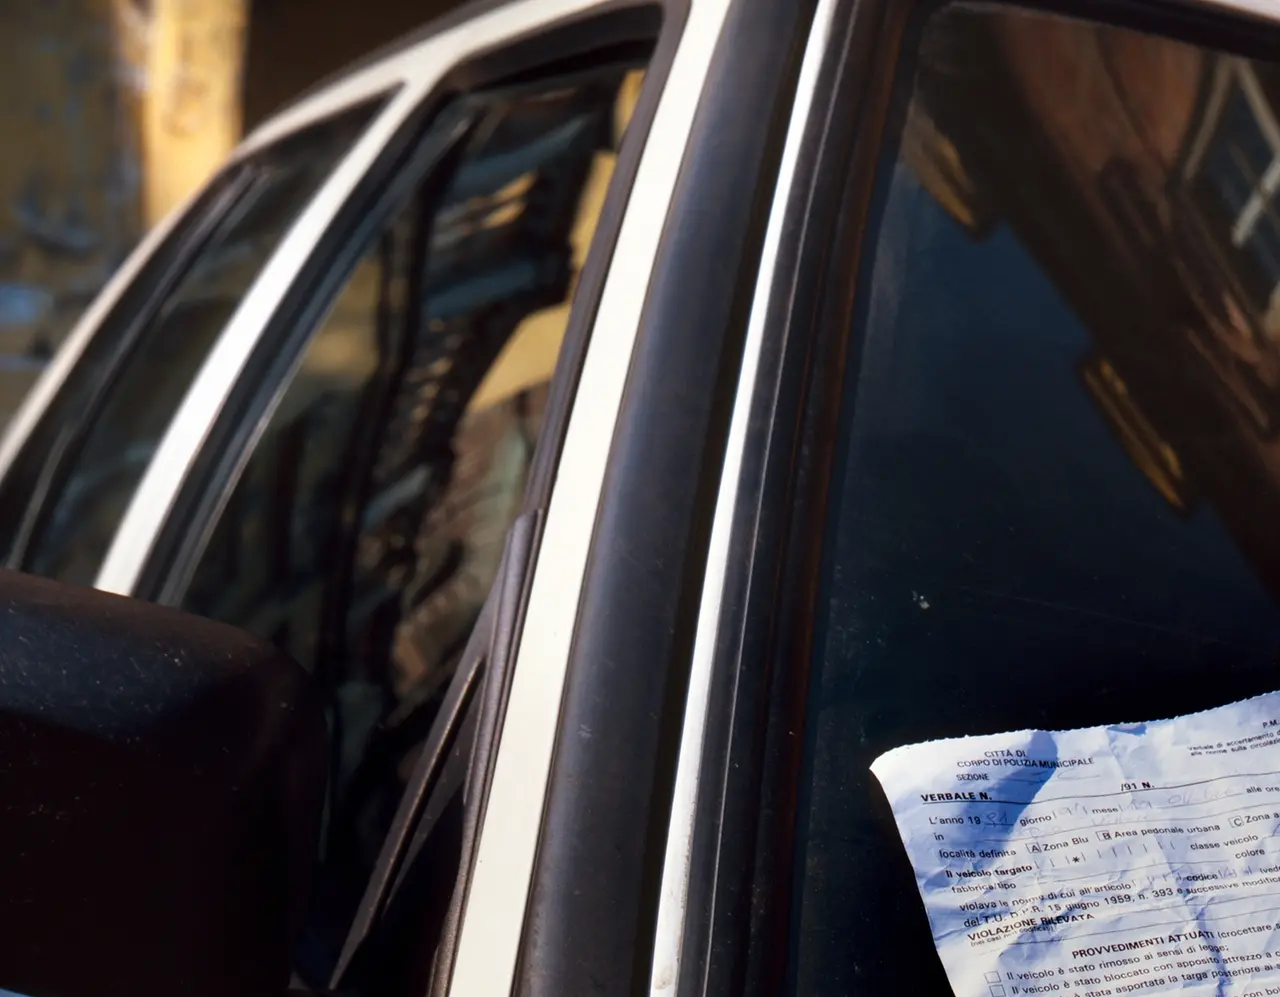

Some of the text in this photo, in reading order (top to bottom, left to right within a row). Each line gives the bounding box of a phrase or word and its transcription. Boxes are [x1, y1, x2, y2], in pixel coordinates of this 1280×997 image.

[984, 749, 1014, 757] CITTÀ
[1003, 759, 1038, 767] POLIZIA
[1039, 758, 1094, 768] MUNICIPALE
[921, 793, 975, 801] VERBALE
[980, 792, 992, 800] N.
[1121, 783, 1137, 791] /91
[929, 816, 964, 824] L'anno
[968, 816, 980, 824] 19
[1020, 815, 1052, 827] giorno
[939, 849, 975, 859] località
[979, 849, 1016, 858] definita
[1043, 841, 1068, 850] Zona
[1114, 830, 1138, 838] Area
[1141, 826, 1184, 836] pedonale
[1187, 824, 1220, 832] urbana
[1246, 813, 1270, 823] Zona
[946, 870, 953, 878] Il
[994, 865, 1032, 876] targato
[1190, 842, 1220, 850] classe
[1224, 834, 1258, 847] veicolo
[968, 913, 1095, 941] VIOLAZIONE RILEVATA
[1072, 937, 1165, 959] PROVVEDIMENTI
[1168, 931, 1214, 944] ATTUATI
[1007, 972, 1014, 980] Il
[1017, 969, 1054, 980] veicolo
[1068, 963, 1095, 973] stato
[1099, 956, 1140, 969] rimosso
[1144, 952, 1153, 960] ai
[1157, 948, 1183, 959] sensi
[1187, 945, 1196, 953] di
[1199, 944, 1229, 953] legge;
[1012, 986, 1019, 994] Il
[1022, 983, 1060, 994] veicolo
[1074, 977, 1100, 987] stato
[1104, 967, 1149, 982] bloccato
[1154, 962, 1174, 972] con
[1177, 957, 1220, 969] apposito
[1223, 954, 1262, 964] attrezzo
[1116, 978, 1165, 994] asportata
[1168, 975, 1178, 983] la
[1181, 970, 1208, 983] targa
[1212, 968, 1262, 981] posteriore
[1264, 965, 1273, 973] ai
